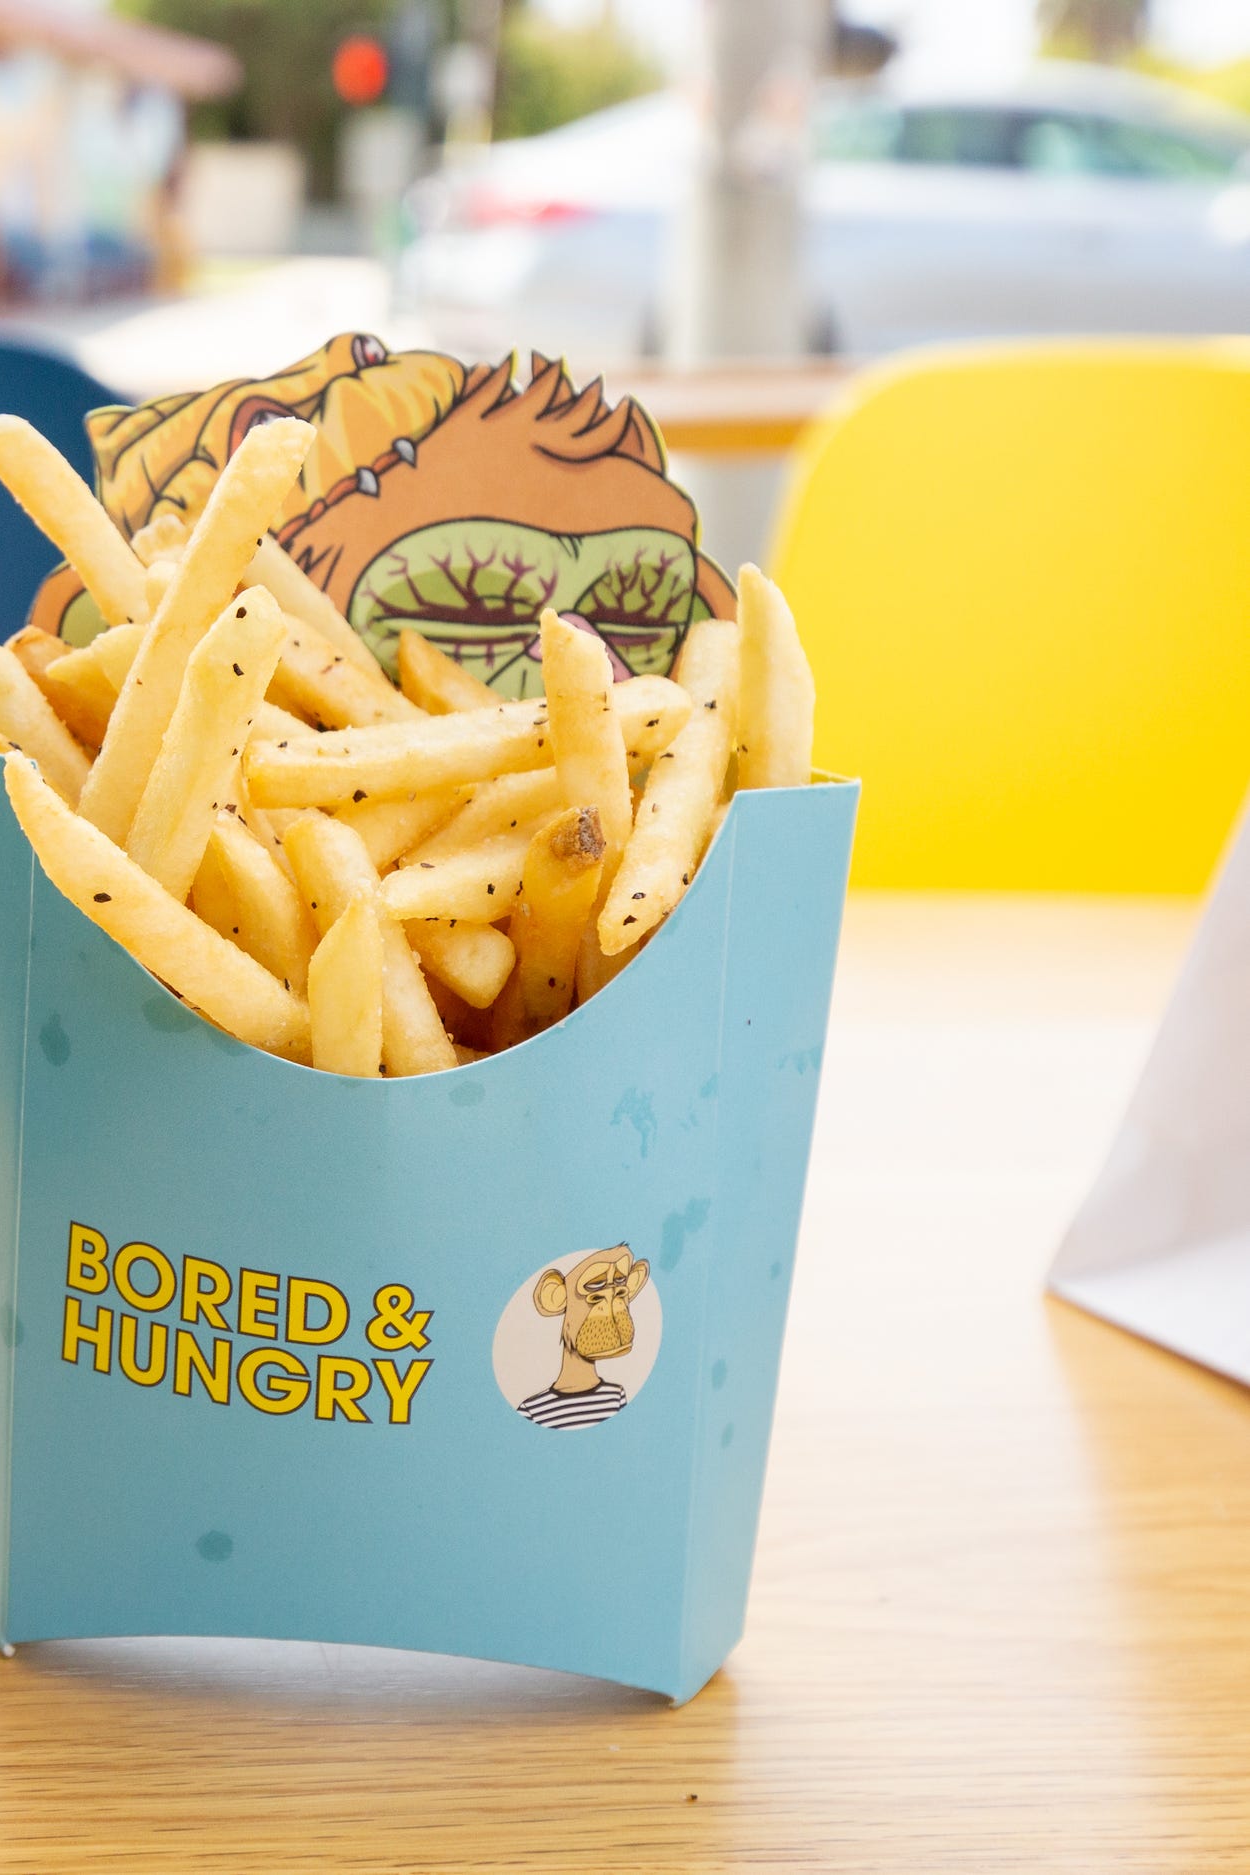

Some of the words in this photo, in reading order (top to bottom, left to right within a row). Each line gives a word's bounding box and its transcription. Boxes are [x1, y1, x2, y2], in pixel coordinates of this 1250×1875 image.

[67, 1221, 350, 1346] BORED
[366, 1284, 435, 1352] &
[62, 1297, 434, 1424] HUNGRY
